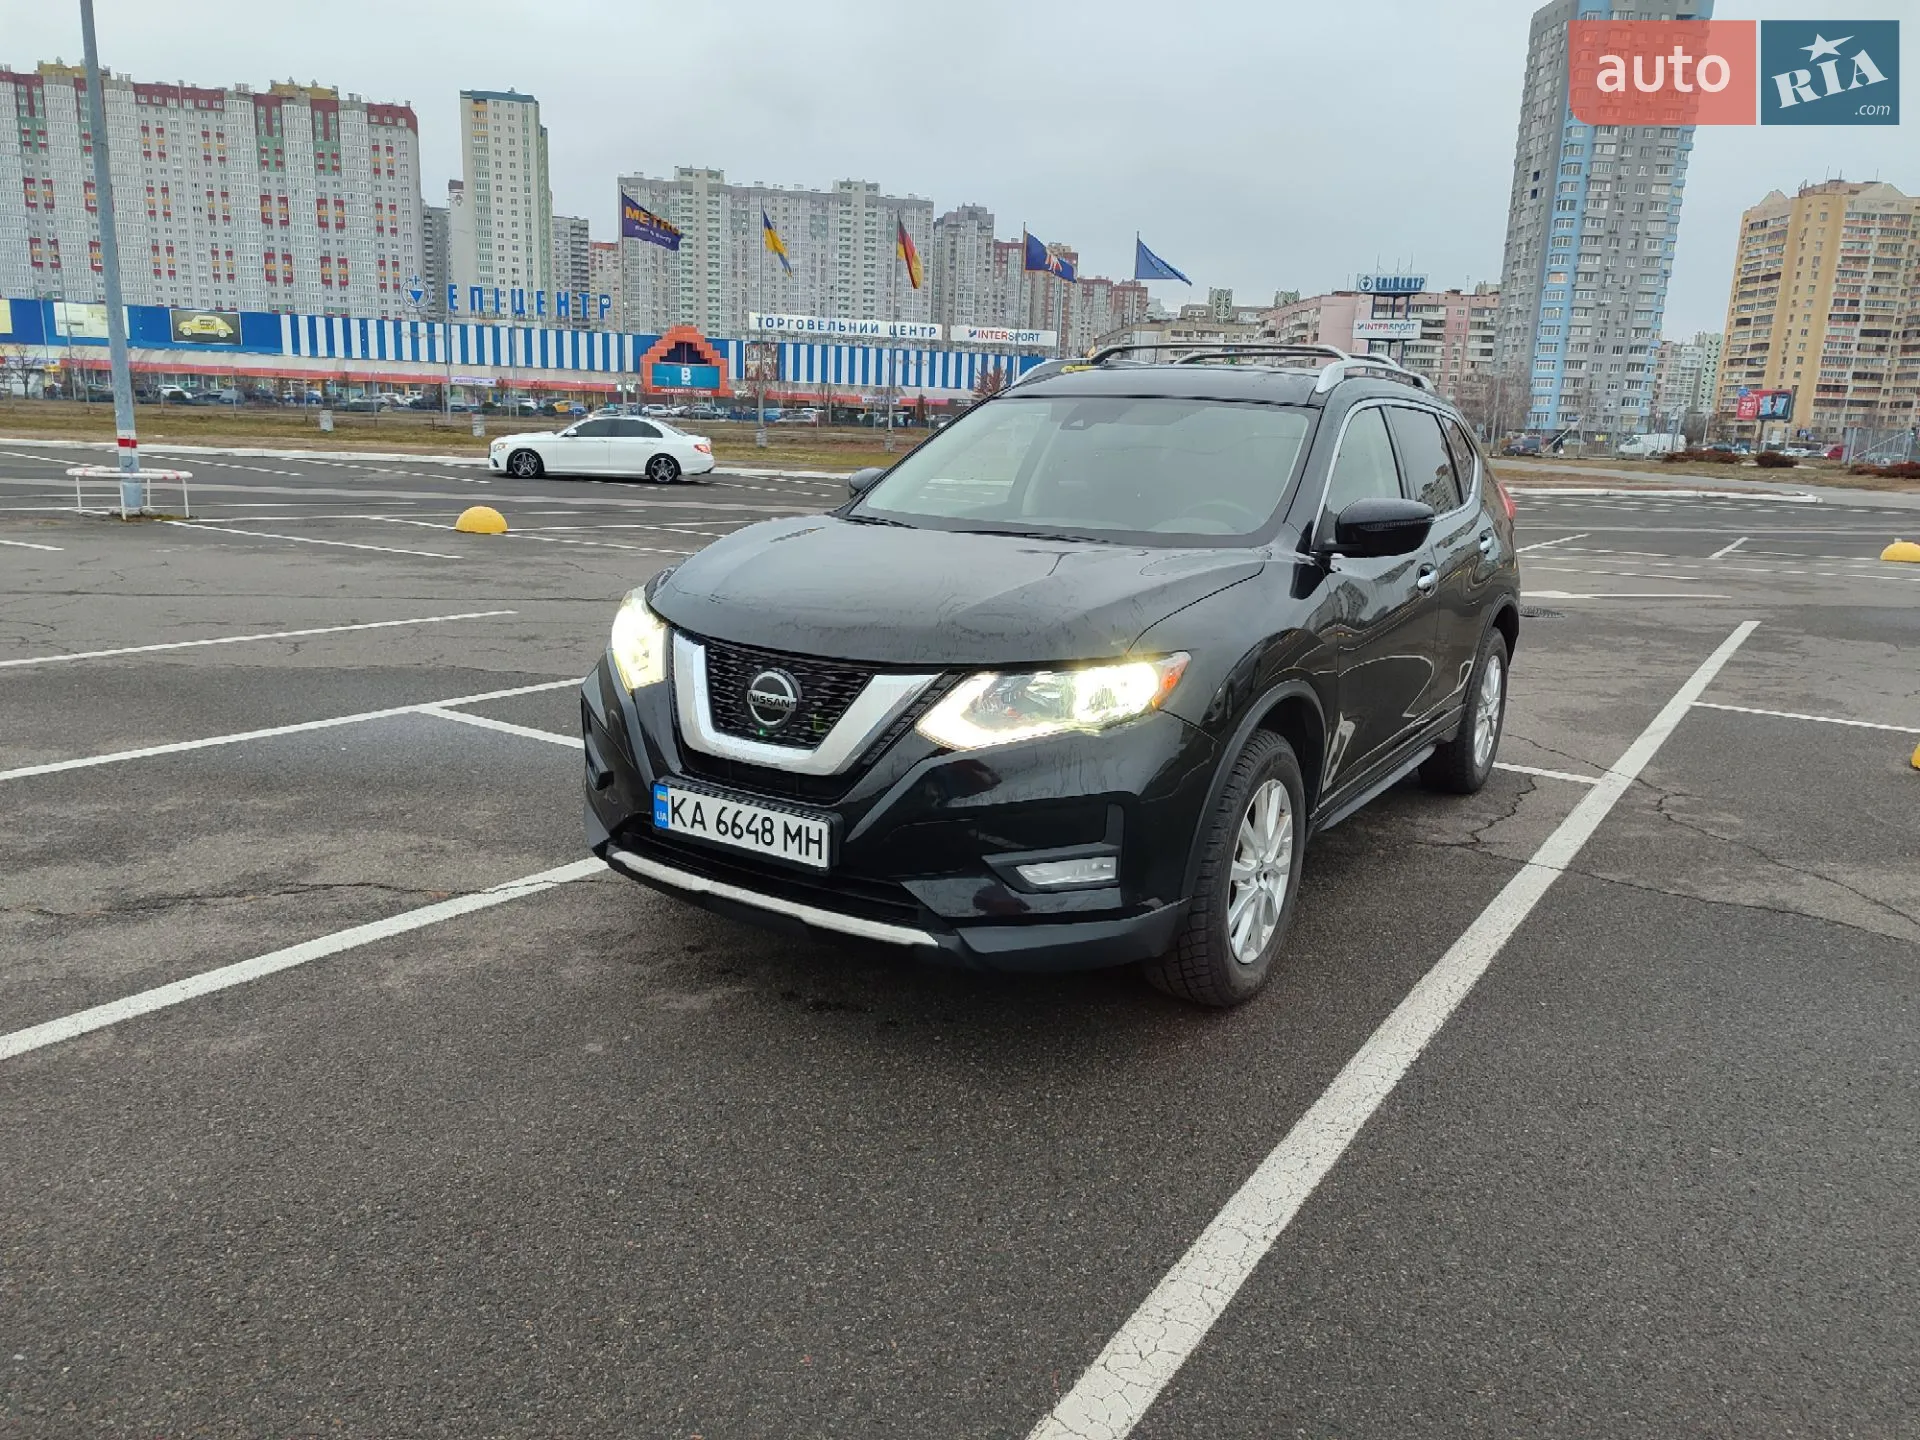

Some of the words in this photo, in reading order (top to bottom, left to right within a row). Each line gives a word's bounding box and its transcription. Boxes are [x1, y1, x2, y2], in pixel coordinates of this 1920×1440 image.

[625, 206, 681, 236] METRO
[447, 283, 612, 320] ЕПІЦЕНТР
[755, 316, 880, 334] ТОРГОВЕЛЬНИЙ
[888, 323, 937, 339] ЦЕНТР
[977, 330, 1041, 342] INTERSPORT
[749, 693, 790, 708] NISSAN
[656, 810, 668, 822] UA
[670, 795, 707, 831] KA
[715, 806, 775, 847] 6648
[783, 820, 823, 860] MH
